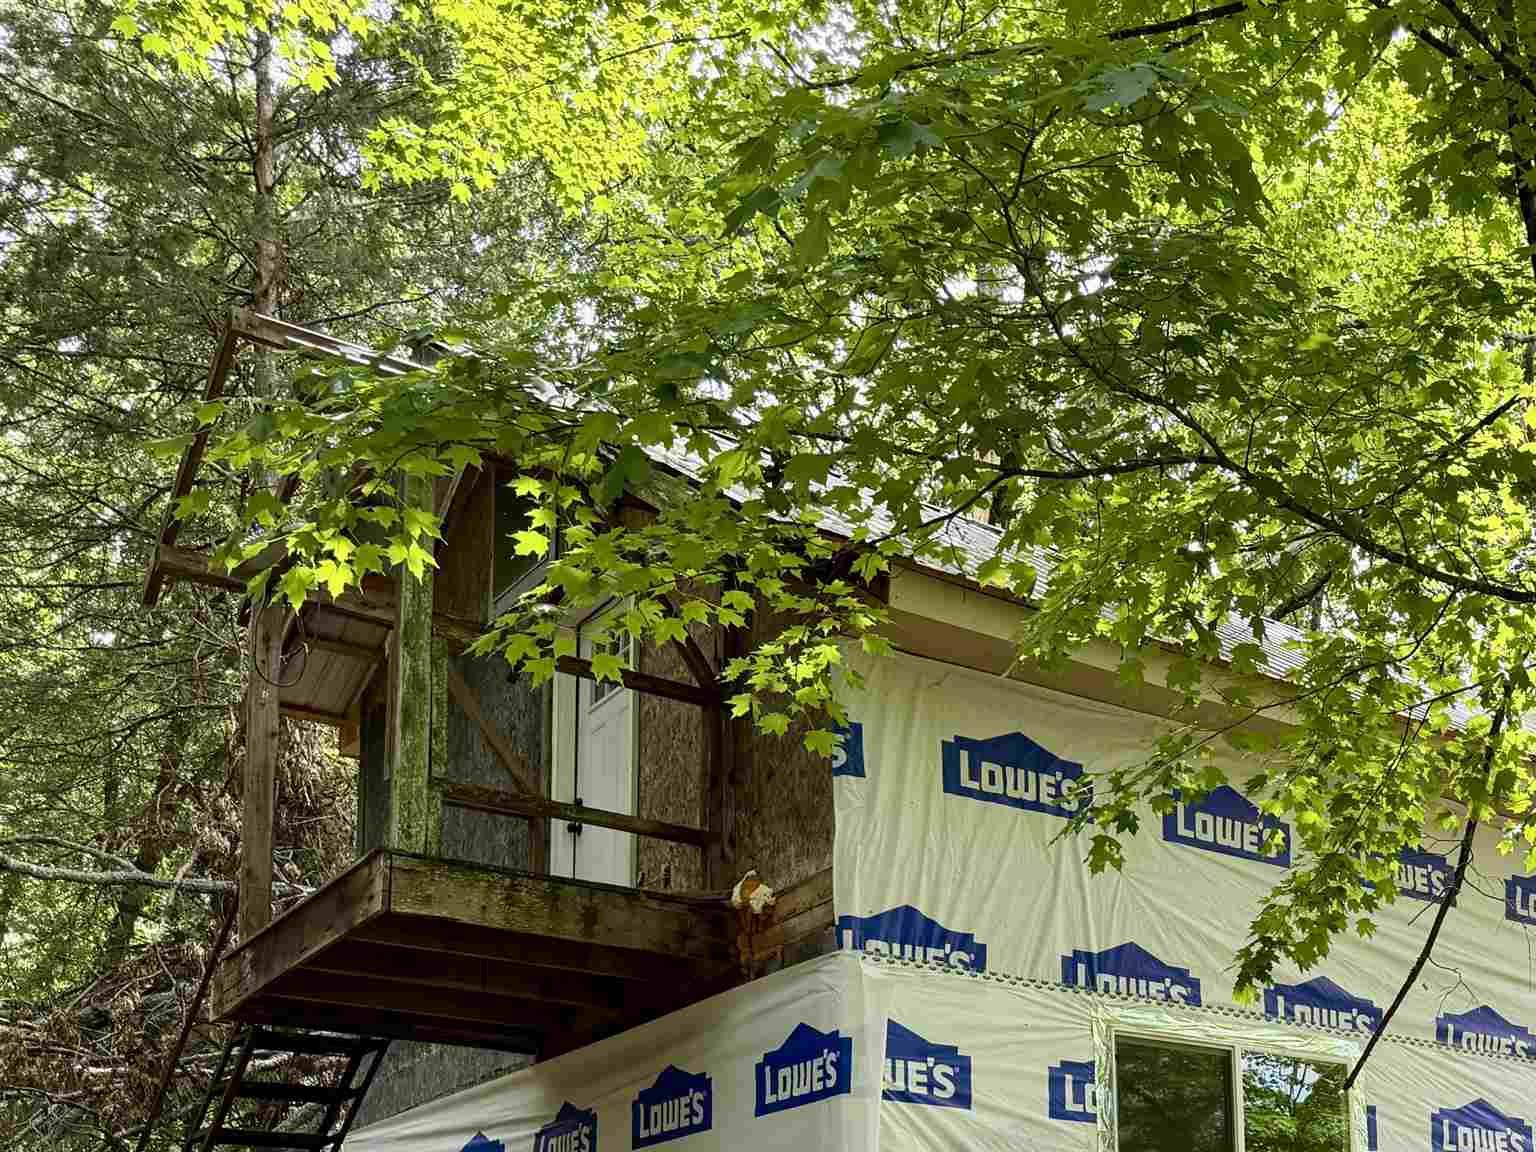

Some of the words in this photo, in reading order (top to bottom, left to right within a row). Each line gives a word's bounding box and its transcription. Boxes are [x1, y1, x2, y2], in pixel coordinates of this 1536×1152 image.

[959, 750, 1079, 811] LOWE'S
[765, 1049, 837, 1104] LOWE'S
[639, 1088, 704, 1138] LOWE'S
